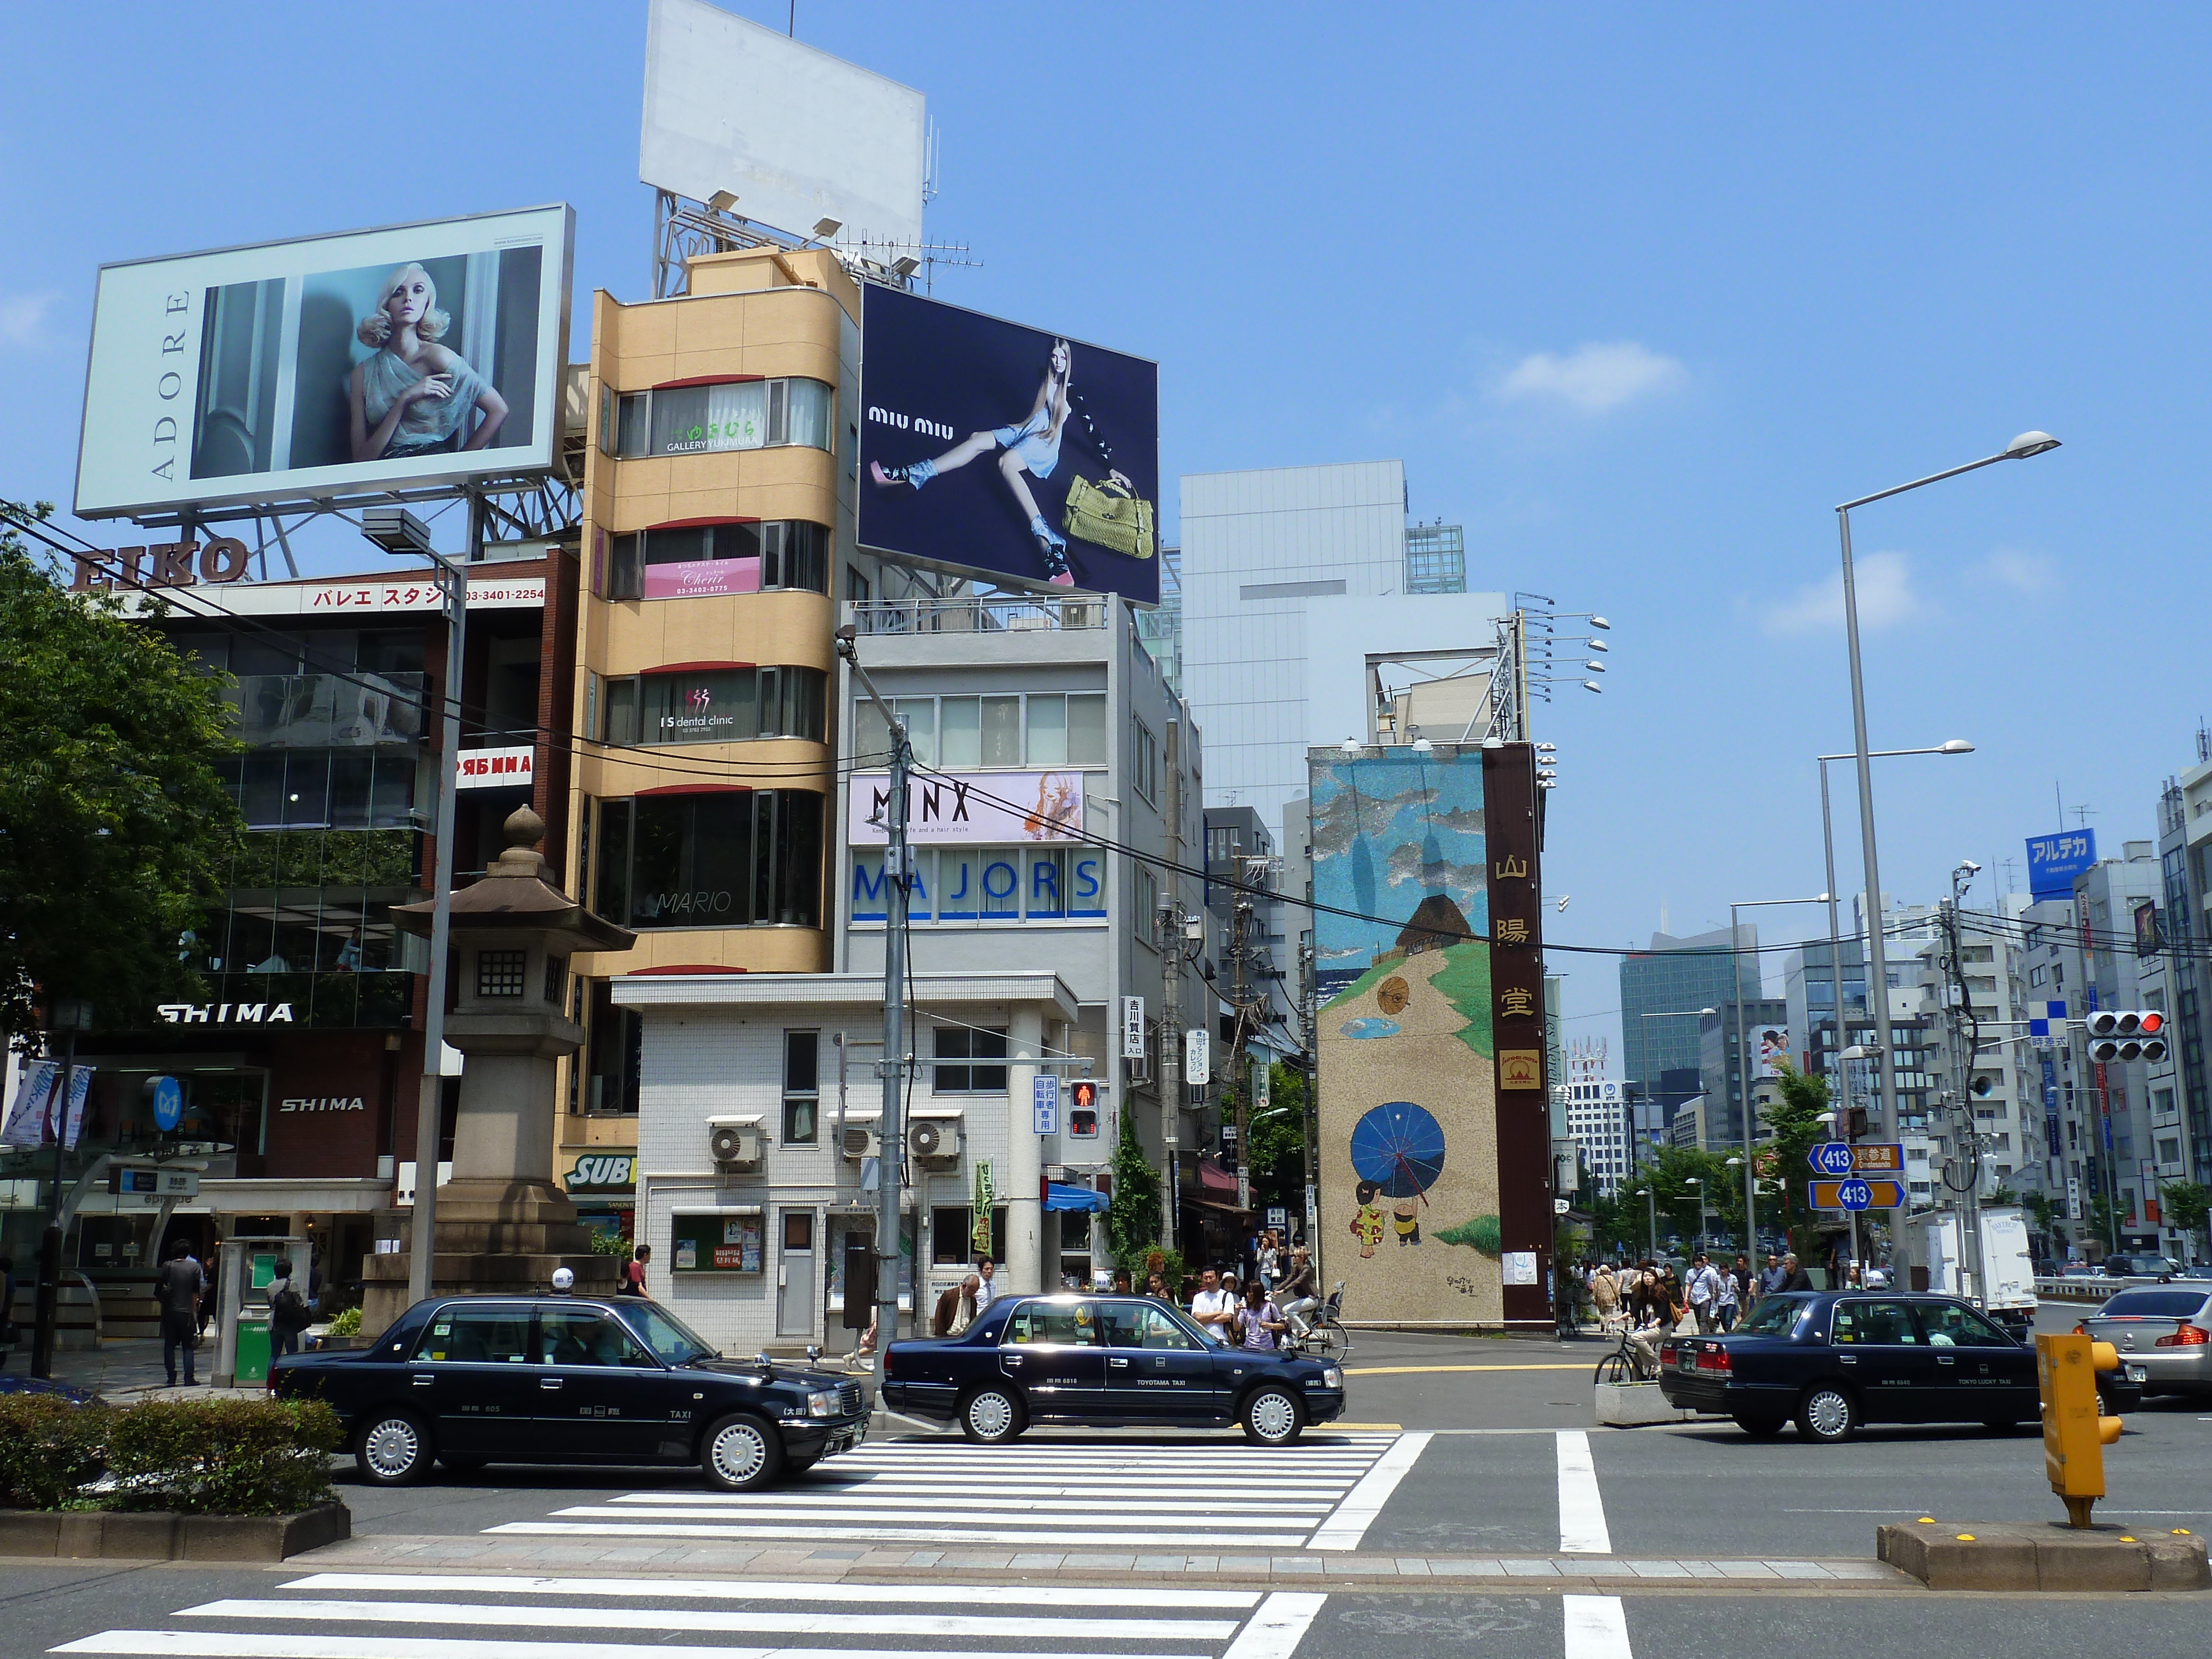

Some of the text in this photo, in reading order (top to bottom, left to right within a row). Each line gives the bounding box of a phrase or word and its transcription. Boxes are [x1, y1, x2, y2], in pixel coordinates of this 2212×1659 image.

[152, 289, 190, 482] ADORE
[687, 420, 754, 441] ゆきむら
[667, 436, 758, 452] GALLERY YUKIMURA
[69, 537, 249, 592] EIKO
[313, 589, 372, 607] バレエ
[677, 585, 728, 594] 03-3402-0775
[676, 716, 706, 727] dental
[708, 713, 733, 726] clinic
[873, 782, 969, 822] MINX
[2032, 836, 2087, 863] アルテカ
[580, 822, 589, 899] MARIO
[656, 891, 732, 914] MARIO
[1495, 854, 1534, 1019] 山陽堂
[156, 1002, 294, 1023] SHIMA
[1129, 999, 1140, 1045] 吉川質店
[1546, 1013, 1558, 1037] Les
[2032, 1036, 2067, 1047] 時差式
[279, 1097, 364, 1112] SHIMA
[1036, 1080, 1045, 1109] 自転車
[1046, 1080, 1055, 1109] 歩行者
[1041, 1110, 1050, 1130] 専用
[1824, 1150, 1850, 1167] 413
[1857, 1147, 1891, 1161] 表参道
[1841, 1186, 1867, 1203] 413
[1556, 1201, 1568, 1212] 本
[670, 1410, 691, 1419] TAXI
